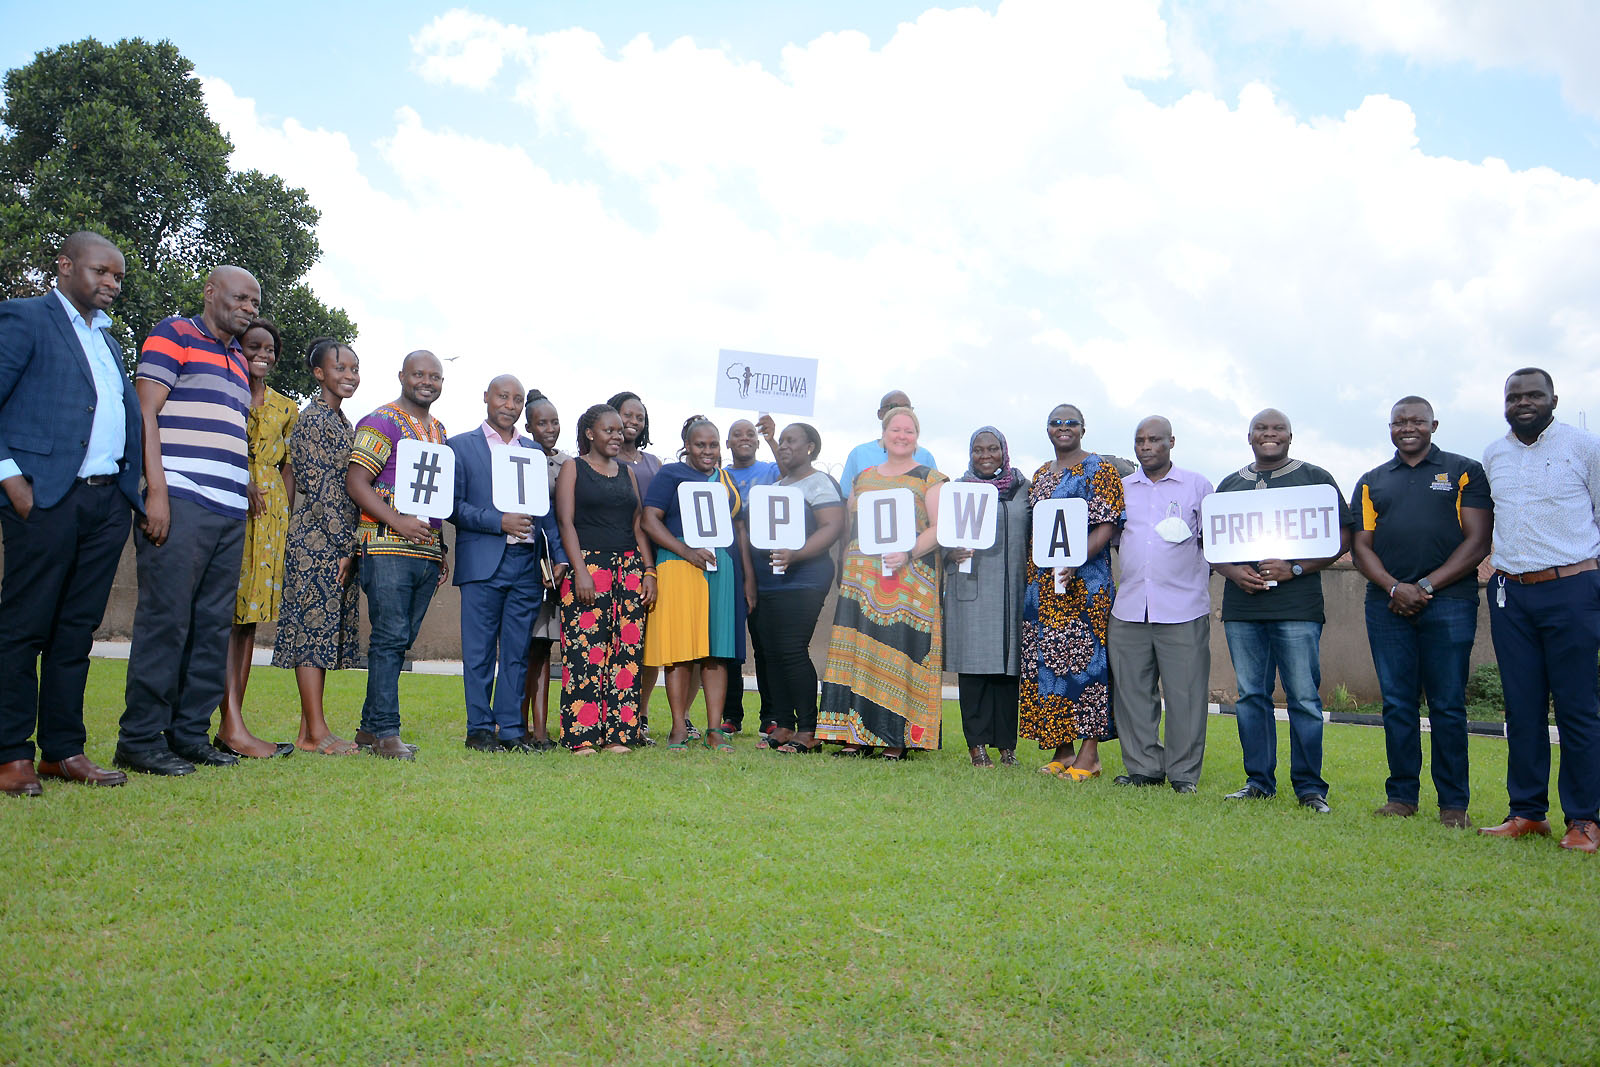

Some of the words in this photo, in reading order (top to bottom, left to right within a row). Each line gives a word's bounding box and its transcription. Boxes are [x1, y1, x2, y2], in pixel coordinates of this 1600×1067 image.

[754, 373, 807, 394] TOPOWA
[410, 451, 441, 505] #
[509, 455, 530, 505] T
[693, 491, 718, 538] O
[768, 495, 790, 541] P
[873, 498, 898, 544] O
[953, 492, 989, 540] W
[1048, 509, 1071, 558] A
[1210, 506, 1334, 546] PROJECT
